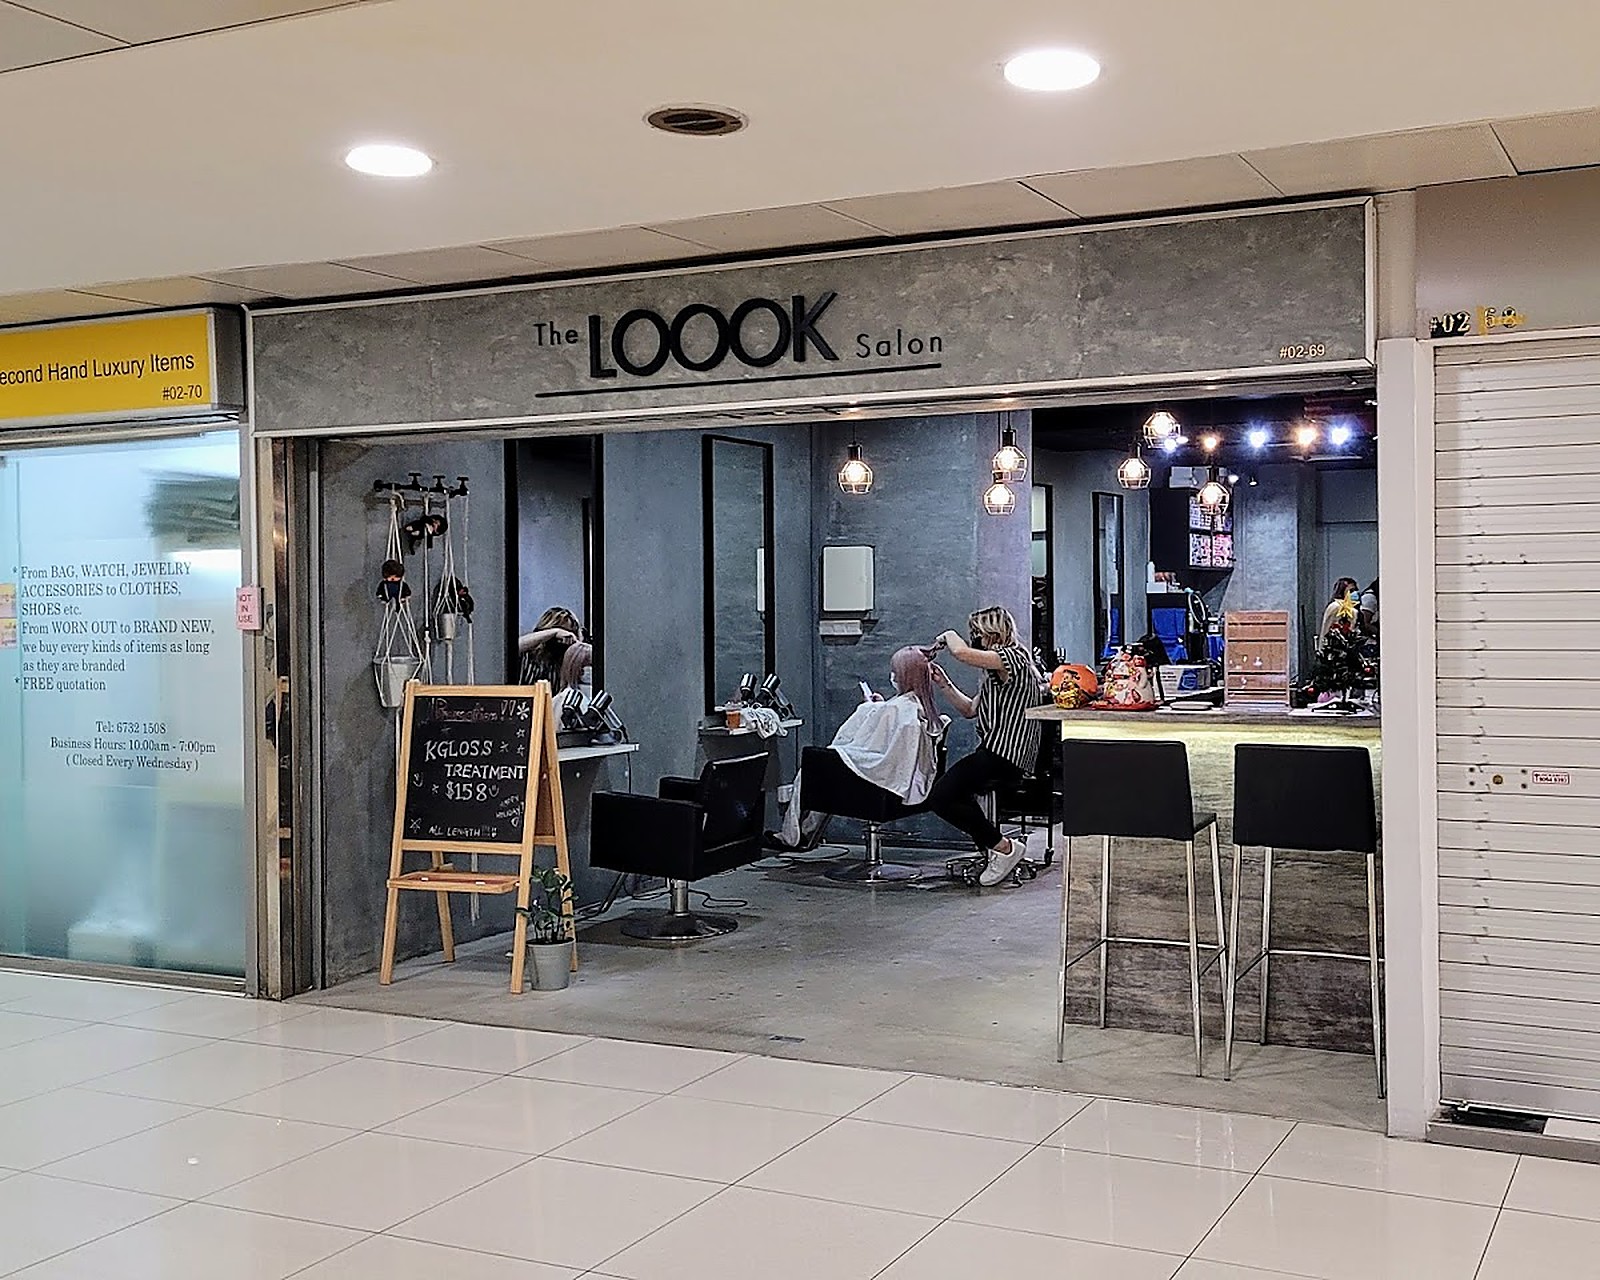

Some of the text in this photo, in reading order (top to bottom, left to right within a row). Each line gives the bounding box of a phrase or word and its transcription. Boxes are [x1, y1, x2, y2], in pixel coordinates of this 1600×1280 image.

[534, 291, 943, 378] The LOOOK Salon
[1279, 343, 1326, 360] #02-69
[49, 359, 88, 381] Hand
[93, 358, 145, 379] Luxury
[151, 353, 195, 373] Items
[163, 385, 203, 401] #02-70
[21, 562, 192, 579] From BAG, WATCH, JEWELRY
[21, 582, 182, 597] ACCESSORIES to CLOTHES,
[22, 602, 82, 616] SHOES etc.
[22, 621, 49, 635] From
[52, 621, 88, 634] WORN
[91, 621, 118, 634] OUT
[120, 623, 131, 634] to
[134, 620, 178, 634] BRAND
[181, 619, 215, 634] NEW,
[22, 639, 210, 656] we buy every kinds of items as long
[22, 658, 126, 675] as they are branded
[22, 677, 106, 693] FREE quotation
[95, 721, 114, 733] Tel:
[116, 722, 140, 734] 6732
[50, 737, 92, 749] Business
[94, 738, 126, 750] Hours:
[179, 740, 216, 755] 7:00pm
[424, 740, 493, 762] KGLOSS
[106, 755, 134, 770] Every
[444, 763, 527, 780] TREATMENT
[445, 781, 488, 801] $158
